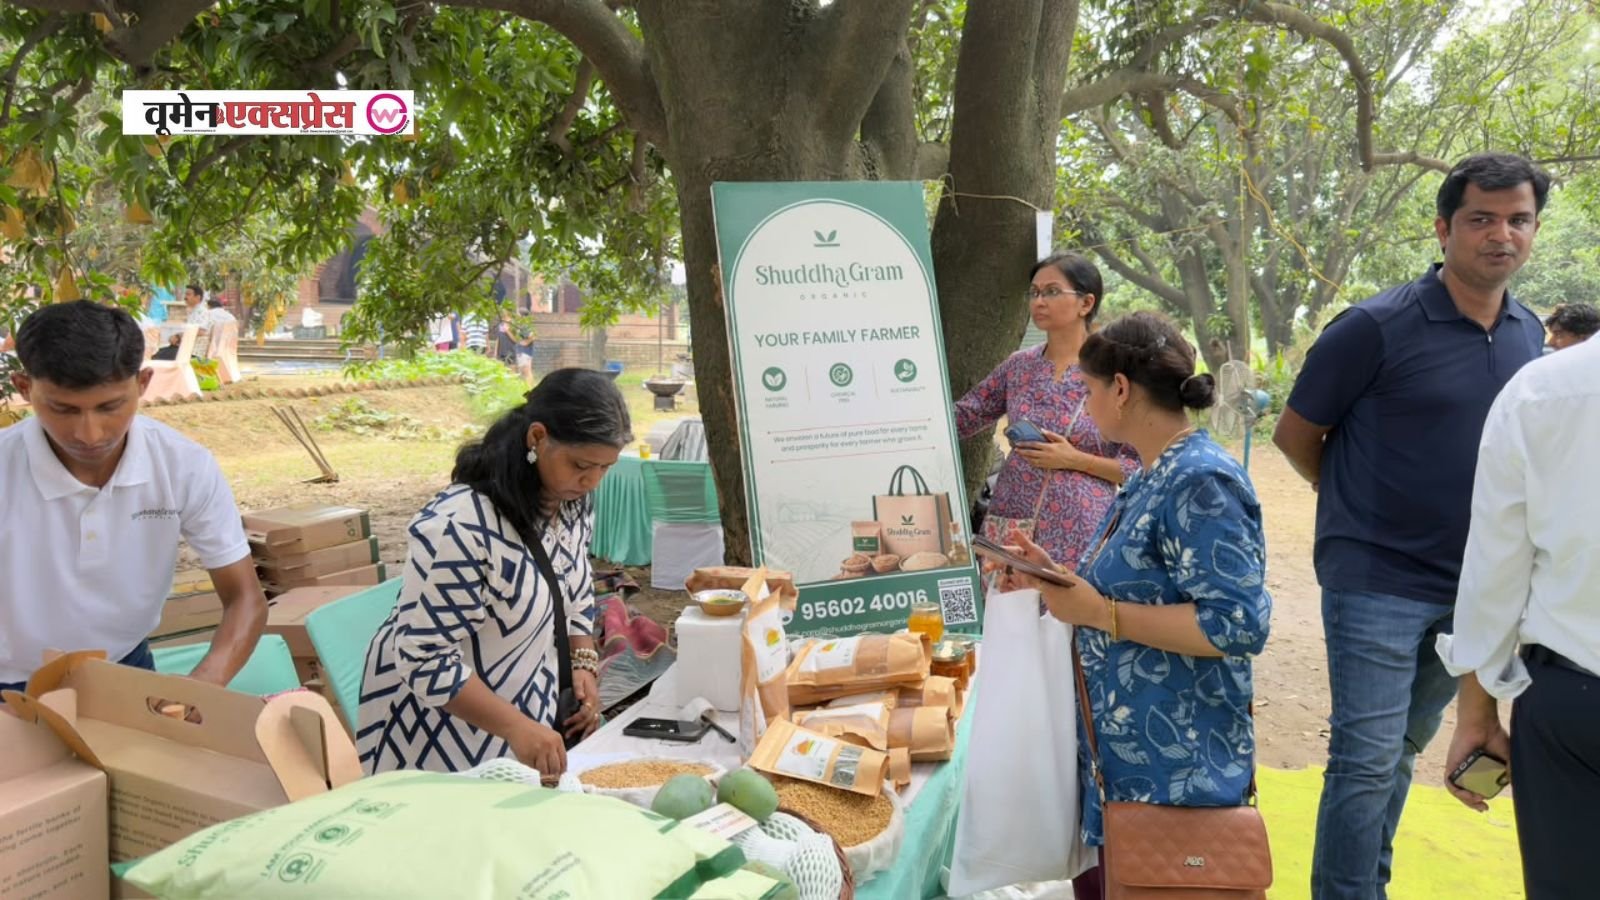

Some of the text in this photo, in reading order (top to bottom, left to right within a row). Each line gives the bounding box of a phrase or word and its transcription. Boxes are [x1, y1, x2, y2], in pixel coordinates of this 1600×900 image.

[755, 262, 904, 288] Shuddha Gram
[800, 291, 868, 301] ORGANIC
[754, 325, 920, 348] YOUR FAMILY FARMER
[848, 430, 863, 438] pure
[840, 440, 858, 448] every
[801, 588, 928, 621] 95602 40016
